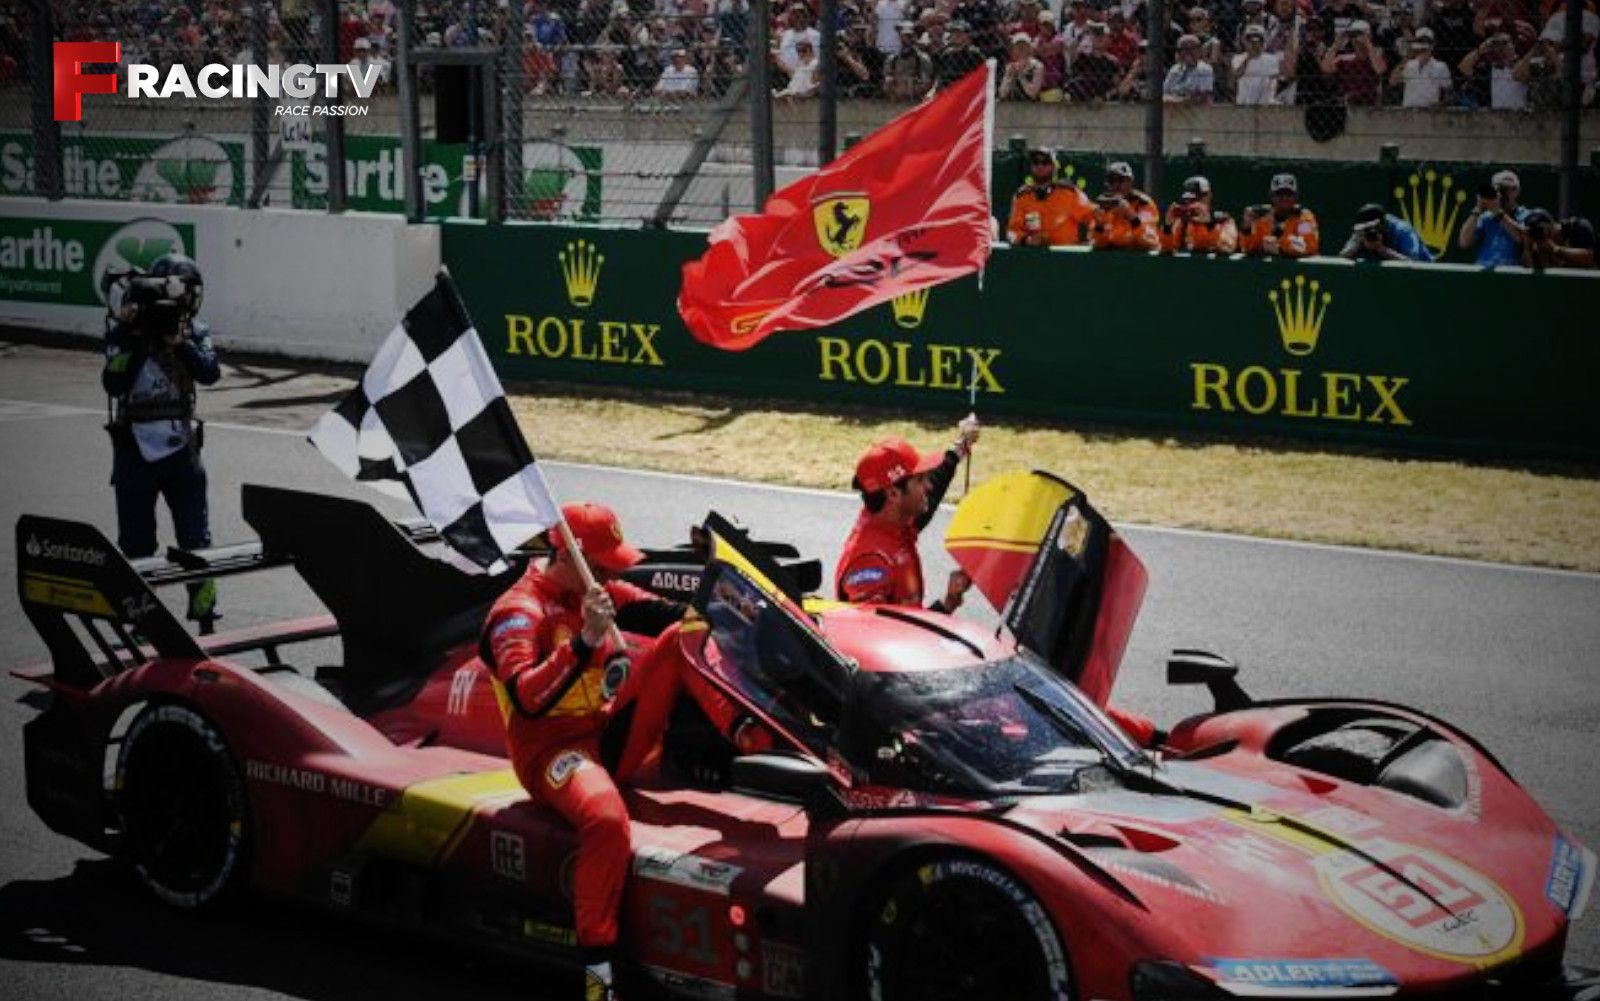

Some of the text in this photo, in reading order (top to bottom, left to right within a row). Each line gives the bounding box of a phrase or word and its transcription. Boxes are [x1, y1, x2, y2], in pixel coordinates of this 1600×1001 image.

[2, 142, 122, 197] Sthe
[0, 226, 85, 273] arthe
[505, 314, 664, 366] ROLEX
[817, 336, 1005, 393] ROLEX
[1189, 362, 1413, 426] ROLEX
[651, 571, 702, 593] ADLER
[246, 759, 387, 807] RICHARD MILLE
[1340, 854, 1487, 929] 51
[649, 894, 721, 965] 51
[1233, 963, 1329, 983] ADLER
